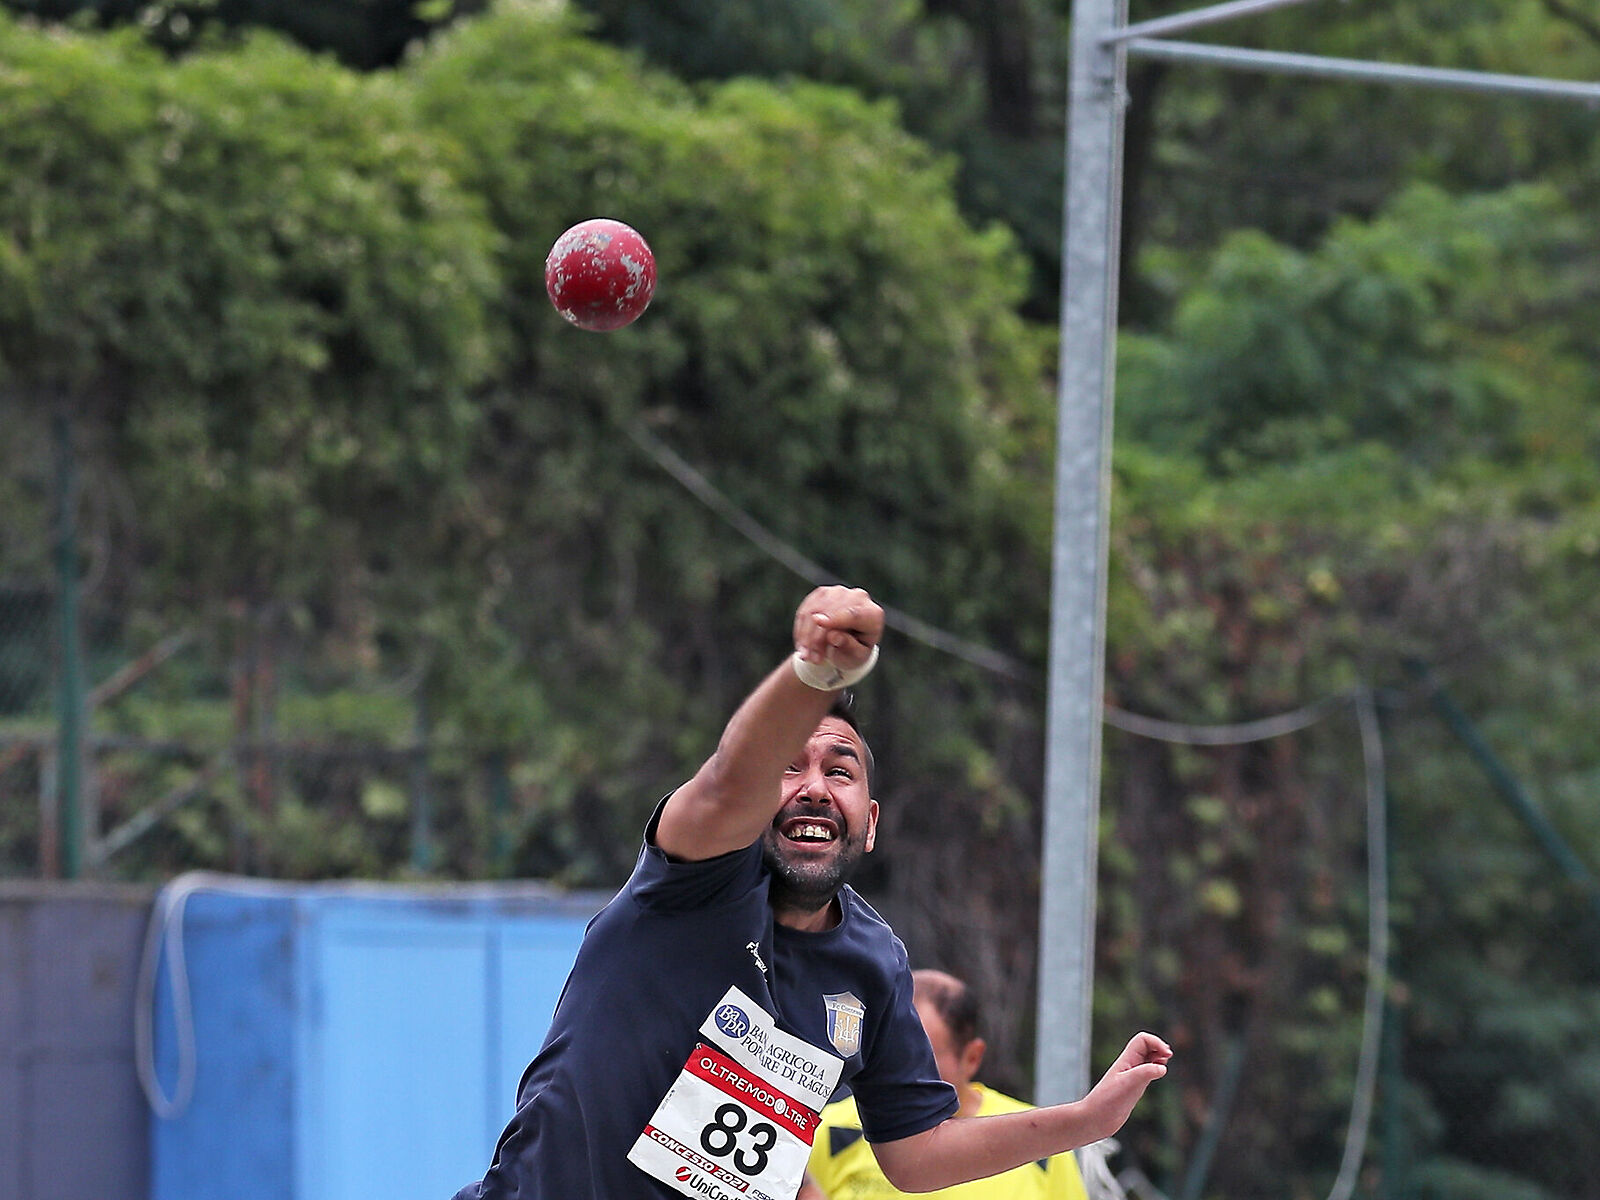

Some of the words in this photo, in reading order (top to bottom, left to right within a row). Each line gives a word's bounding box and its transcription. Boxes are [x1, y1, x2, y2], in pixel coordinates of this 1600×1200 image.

[699, 1057, 808, 1130] OLTREMODOLTRE
[766, 1044, 825, 1080] AGRICOLA
[781, 1066, 798, 1081] DI
[650, 1129, 715, 1172] CONCESIO
[712, 1168, 748, 1193] 2021
[700, 1102, 777, 1176] 83
